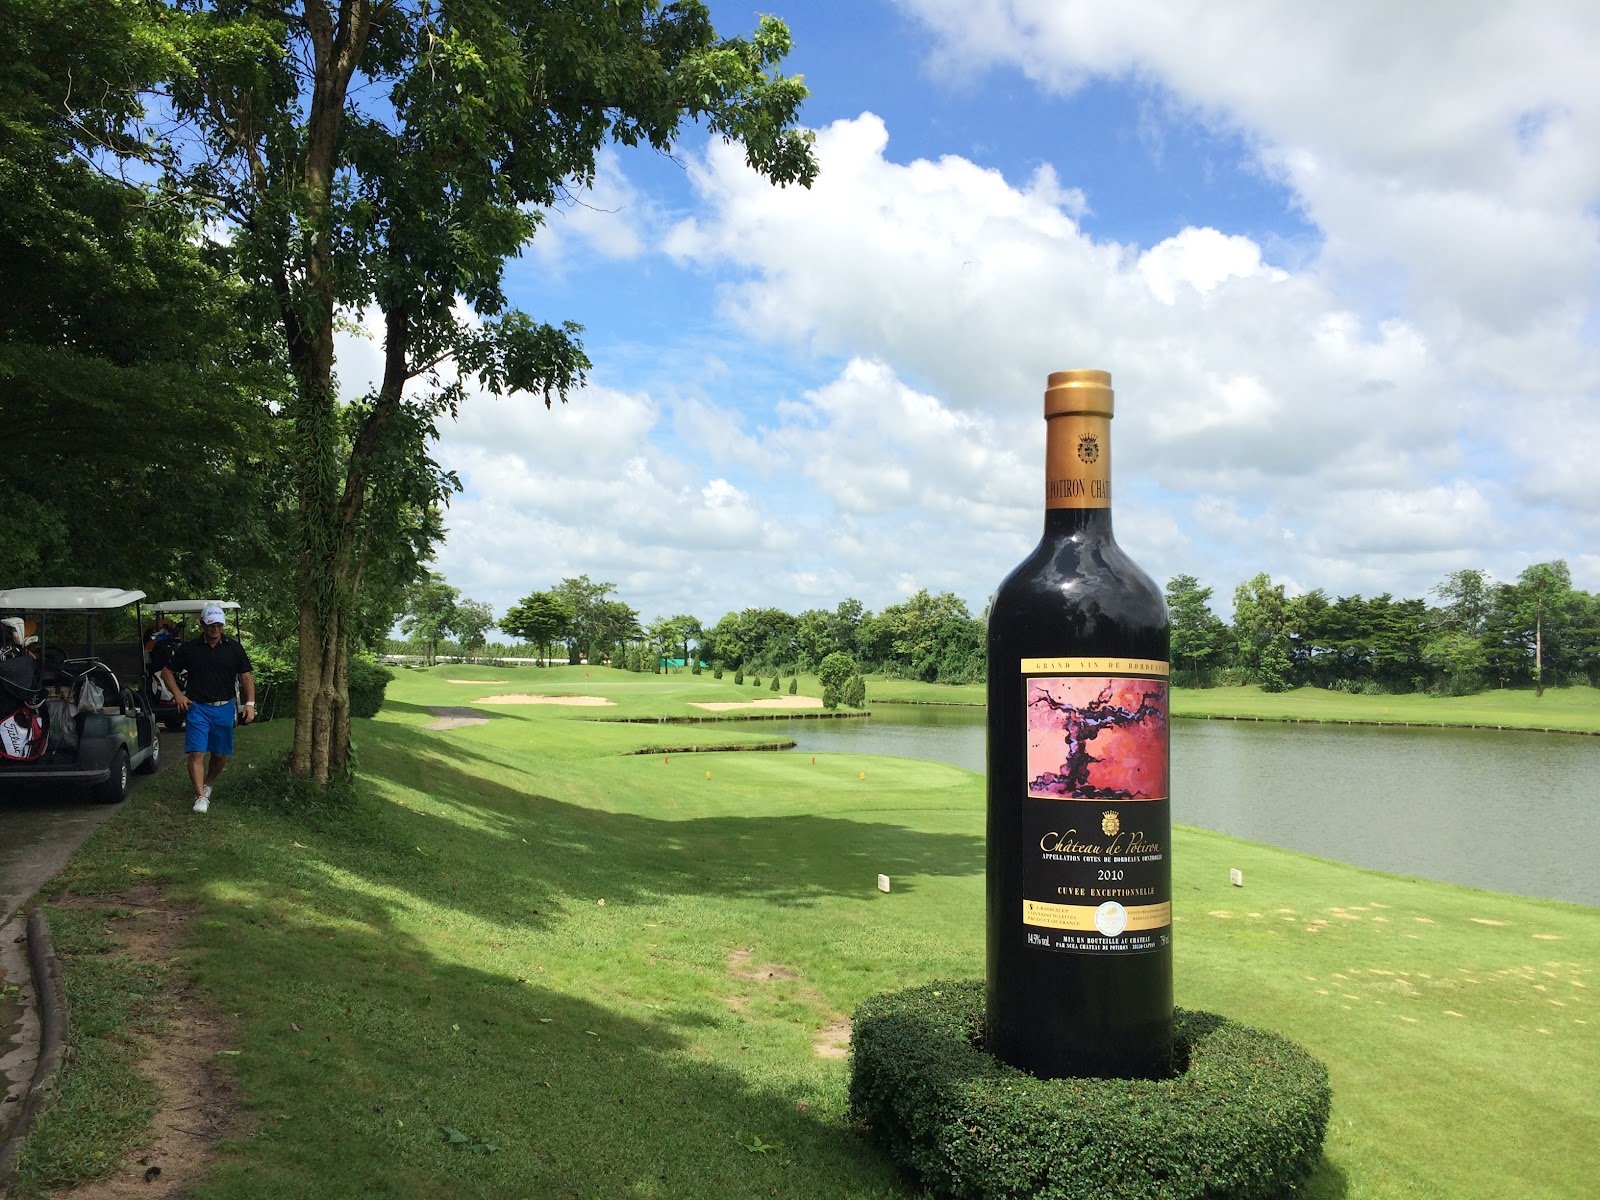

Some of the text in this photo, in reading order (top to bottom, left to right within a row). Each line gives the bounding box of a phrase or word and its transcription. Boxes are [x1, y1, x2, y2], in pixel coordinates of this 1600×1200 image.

[1036, 661, 1070, 669] GRAND
[4, 722, 21, 754] Titleist
[1040, 828, 1160, 855] Château de Potiron
[1042, 853, 1081, 862] APPELLATION
[1103, 855, 1112, 863] DE
[1113, 855, 1141, 863] BORDEAUX
[1097, 869, 1124, 881] 2010
[1090, 887, 1155, 897] EXCEPTIONNELLE
[1055, 941, 1066, 949] PAR
[1063, 935, 1075, 943] MIS
[1076, 936, 1085, 944] EN
[1086, 937, 1119, 945] BOUTEILLE
[1120, 937, 1128, 945] AU
